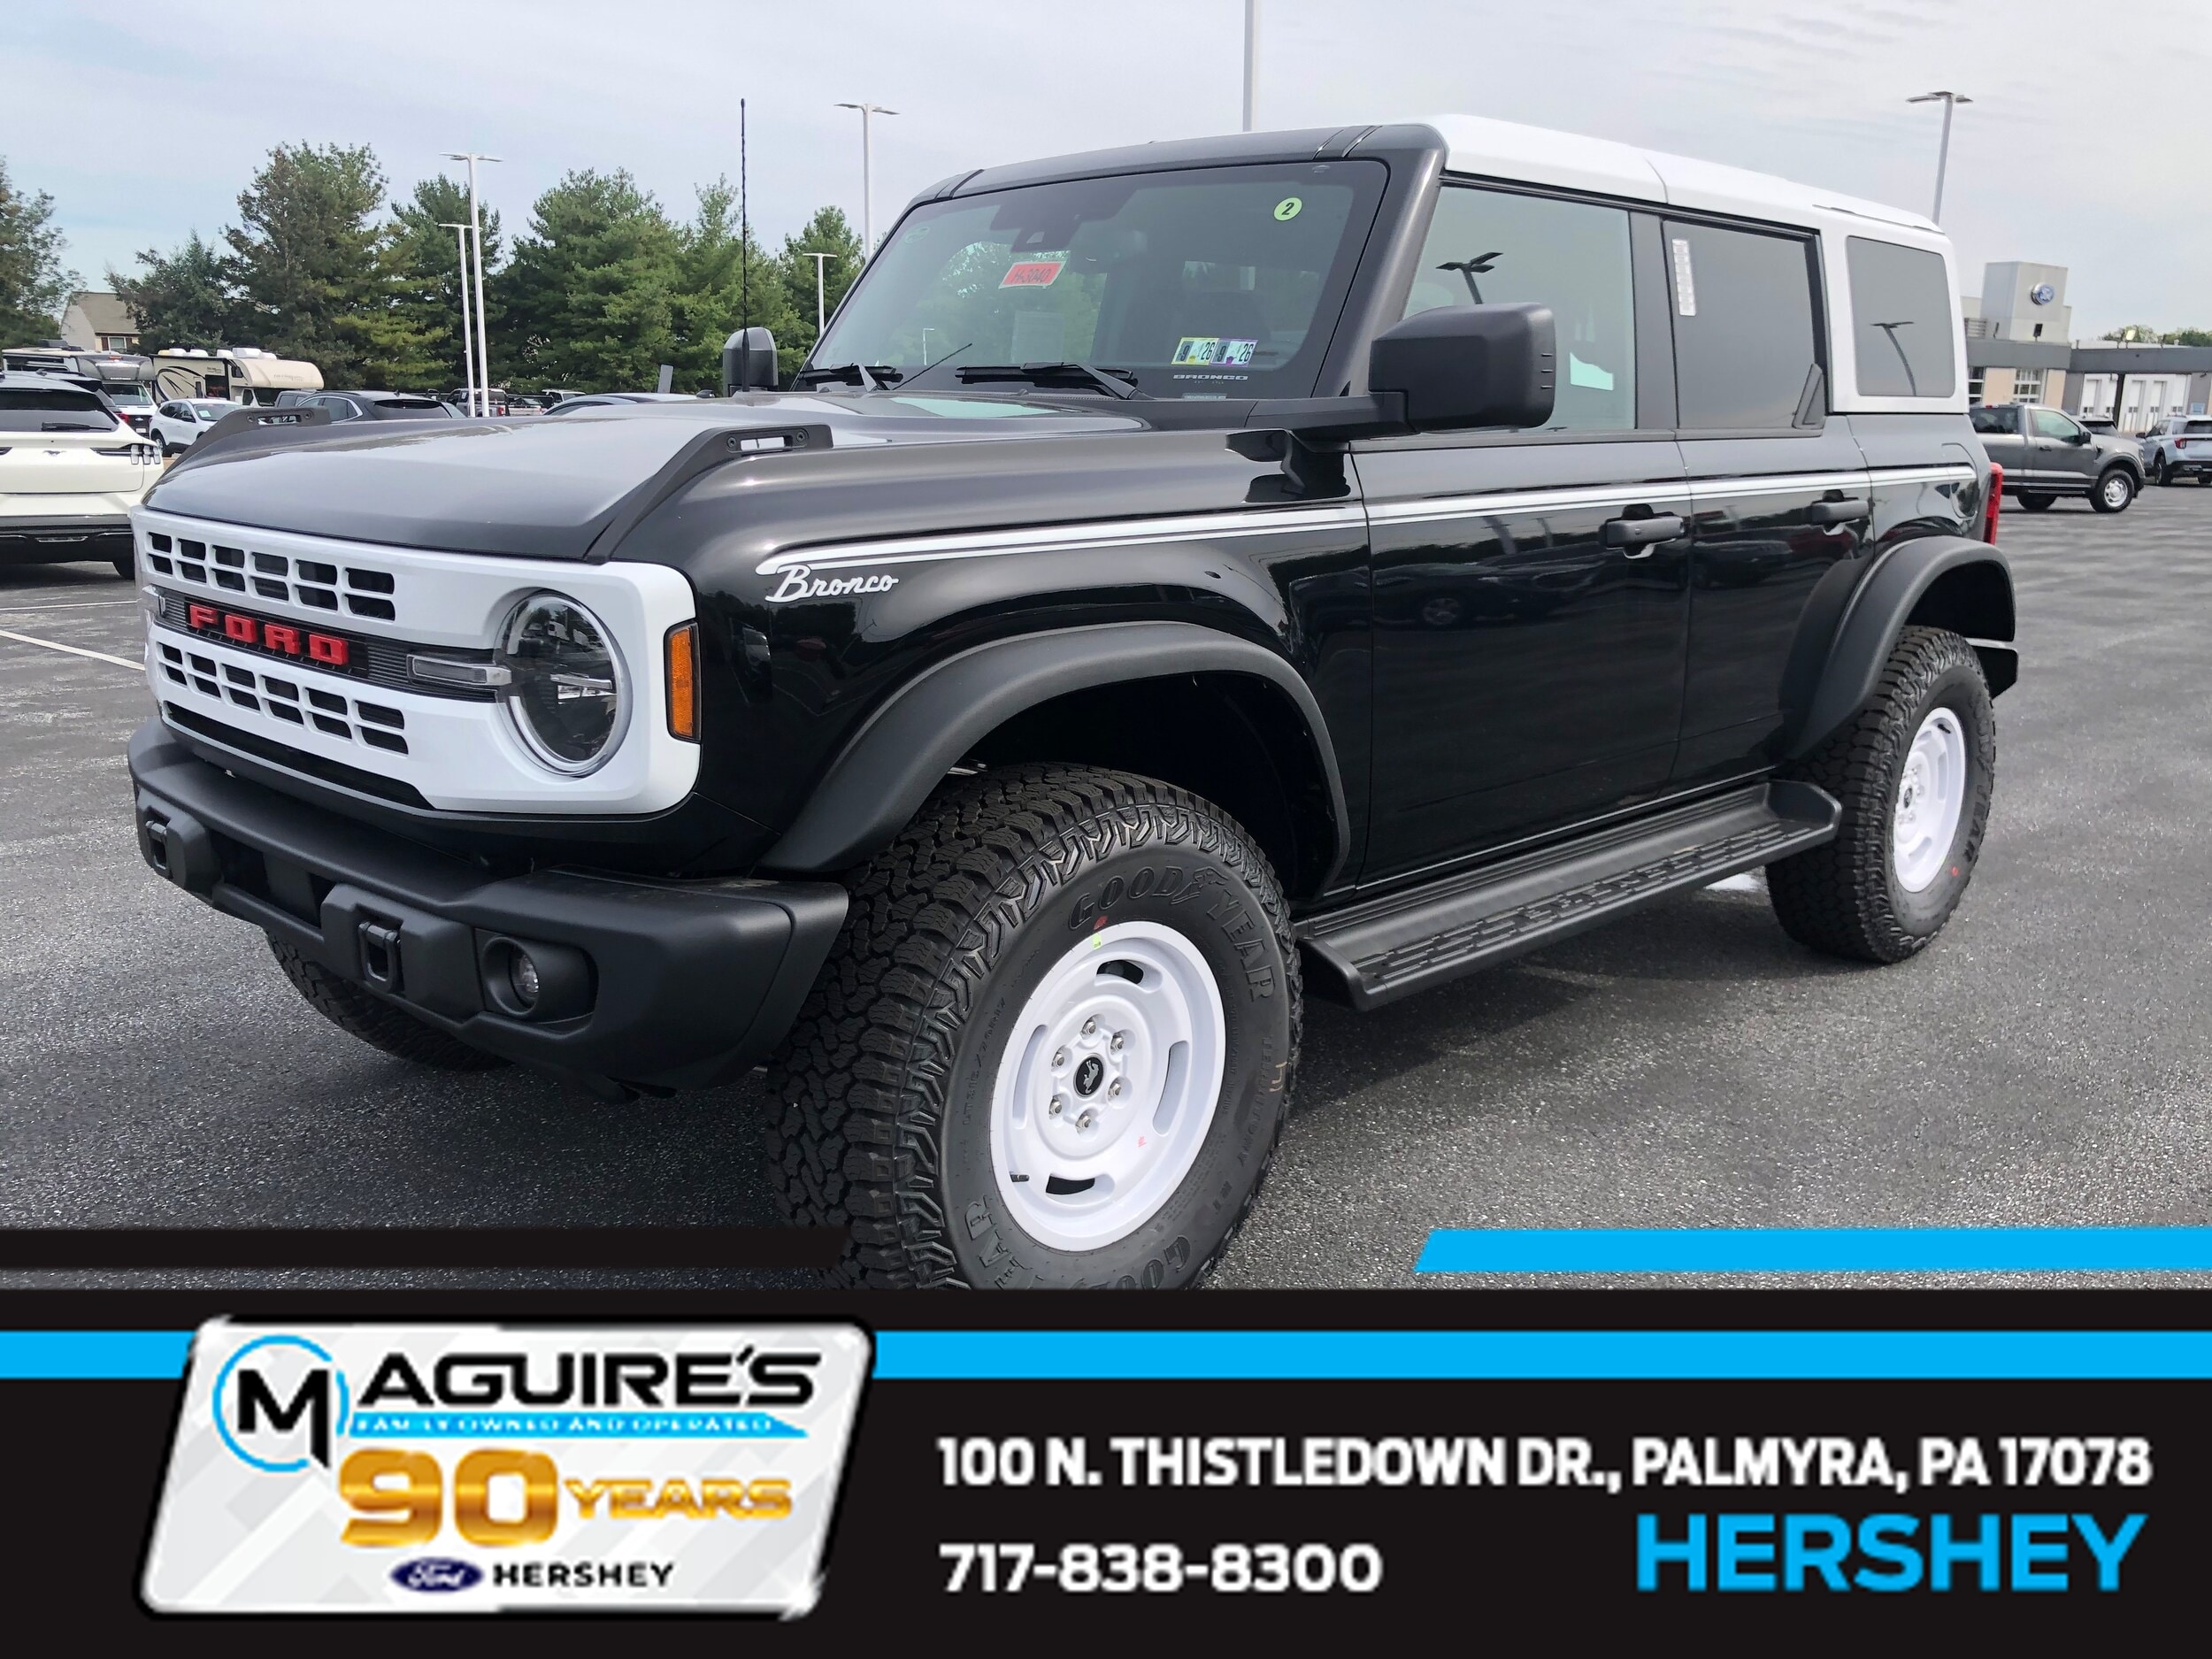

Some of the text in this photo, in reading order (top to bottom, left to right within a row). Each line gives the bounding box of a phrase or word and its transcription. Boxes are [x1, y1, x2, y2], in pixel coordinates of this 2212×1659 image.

[1282, 202, 1294, 215] 2
[1201, 342, 1217, 361] 26
[1239, 342, 1255, 363] 26
[764, 565, 899, 603] Bronco
[189, 604, 349, 665] FORD
